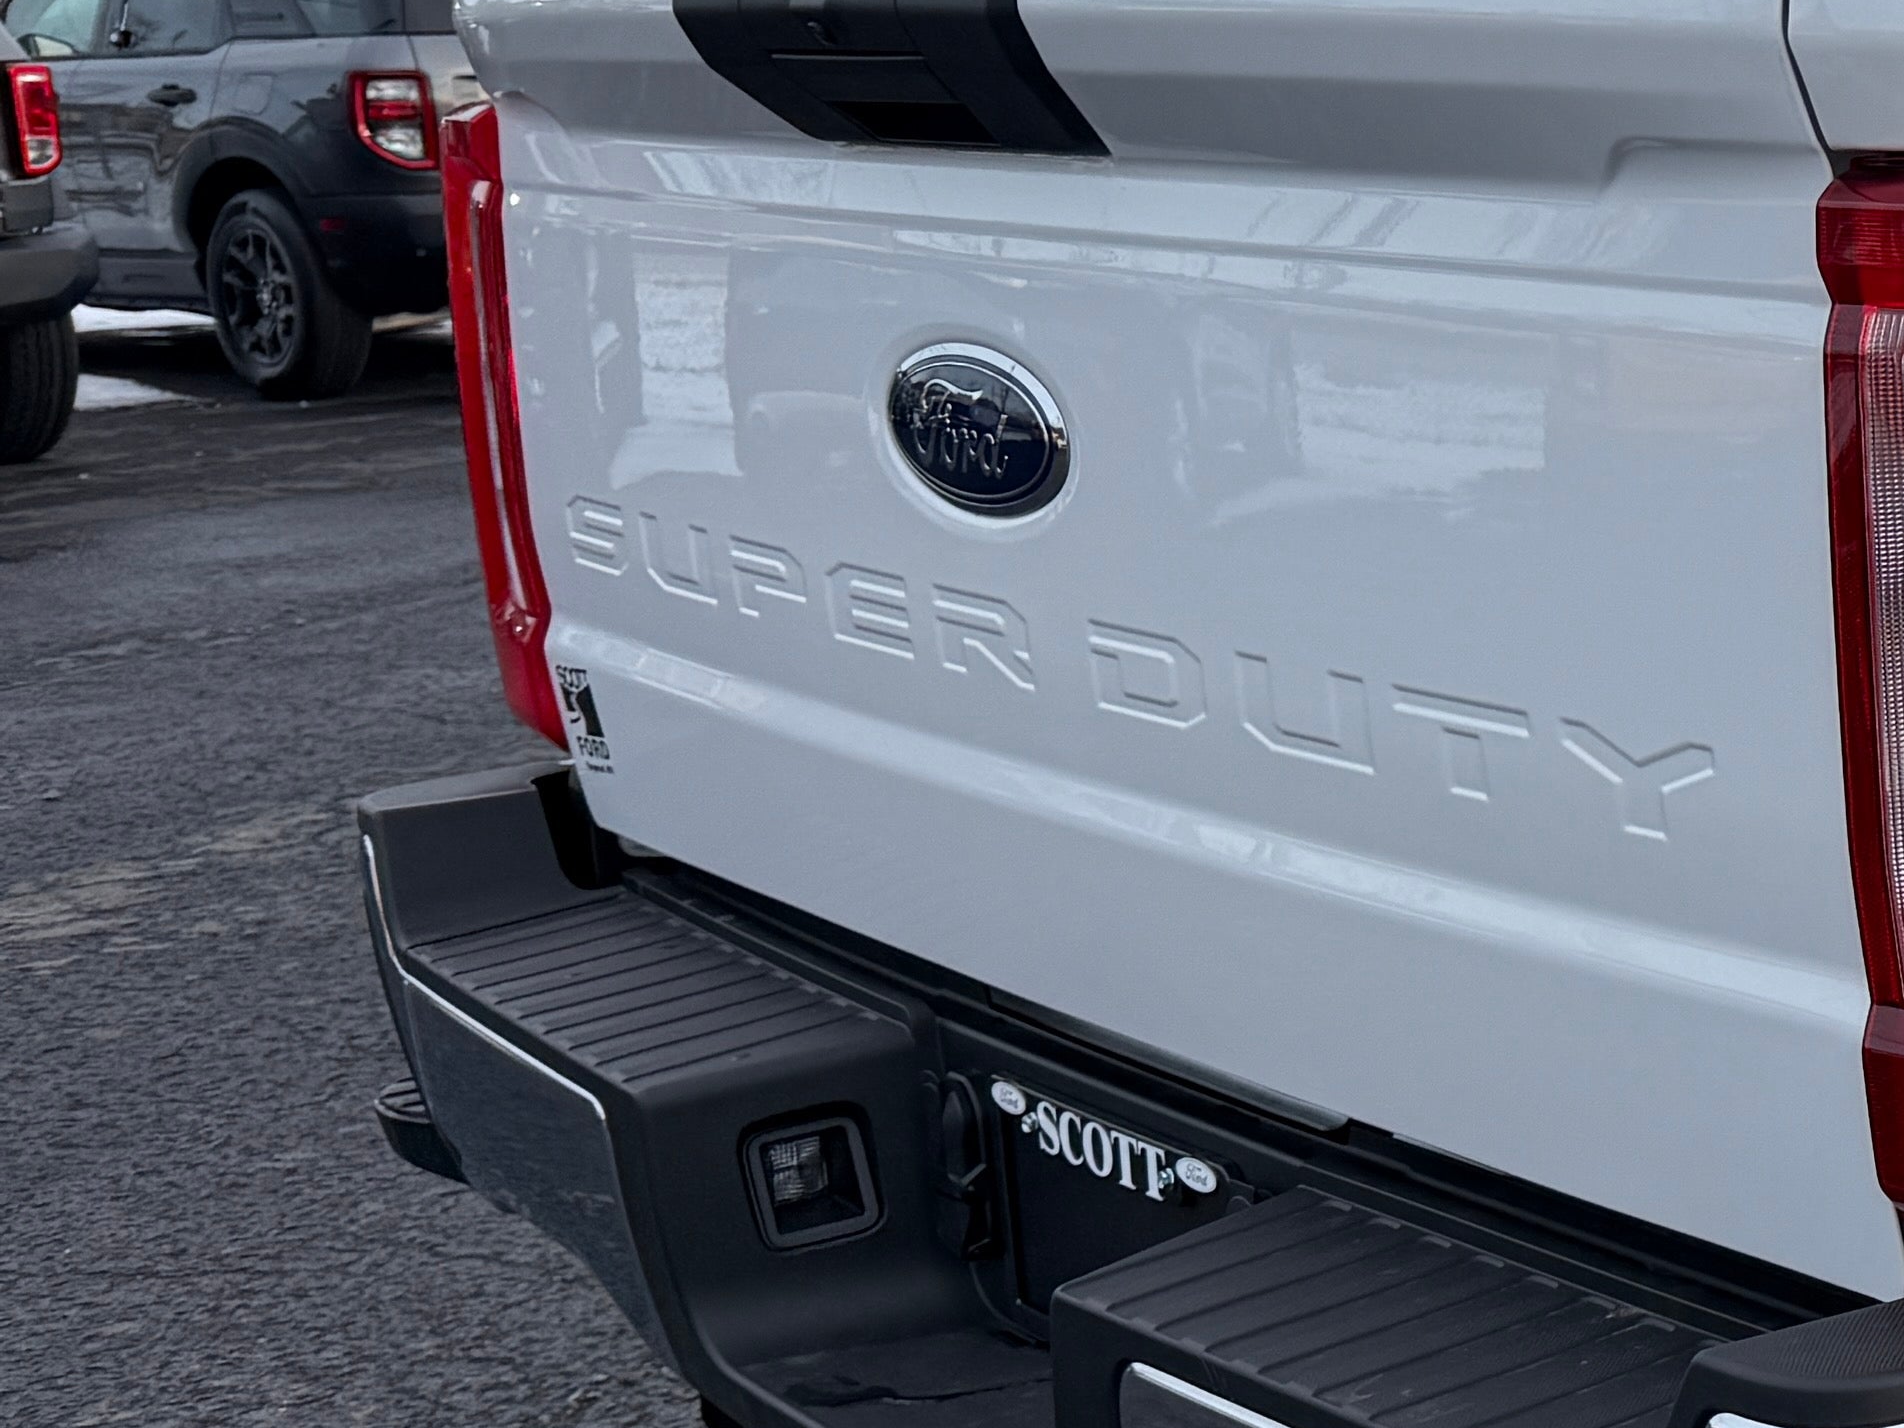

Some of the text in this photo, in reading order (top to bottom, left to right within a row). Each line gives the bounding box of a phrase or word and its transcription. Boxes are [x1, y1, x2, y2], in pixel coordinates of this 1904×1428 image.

[912, 377, 1009, 479] Ford
[566, 494, 1716, 842] SUPER DUTY
[576, 735, 611, 761] FORD
[1036, 1101, 1167, 1202] SCOTT
